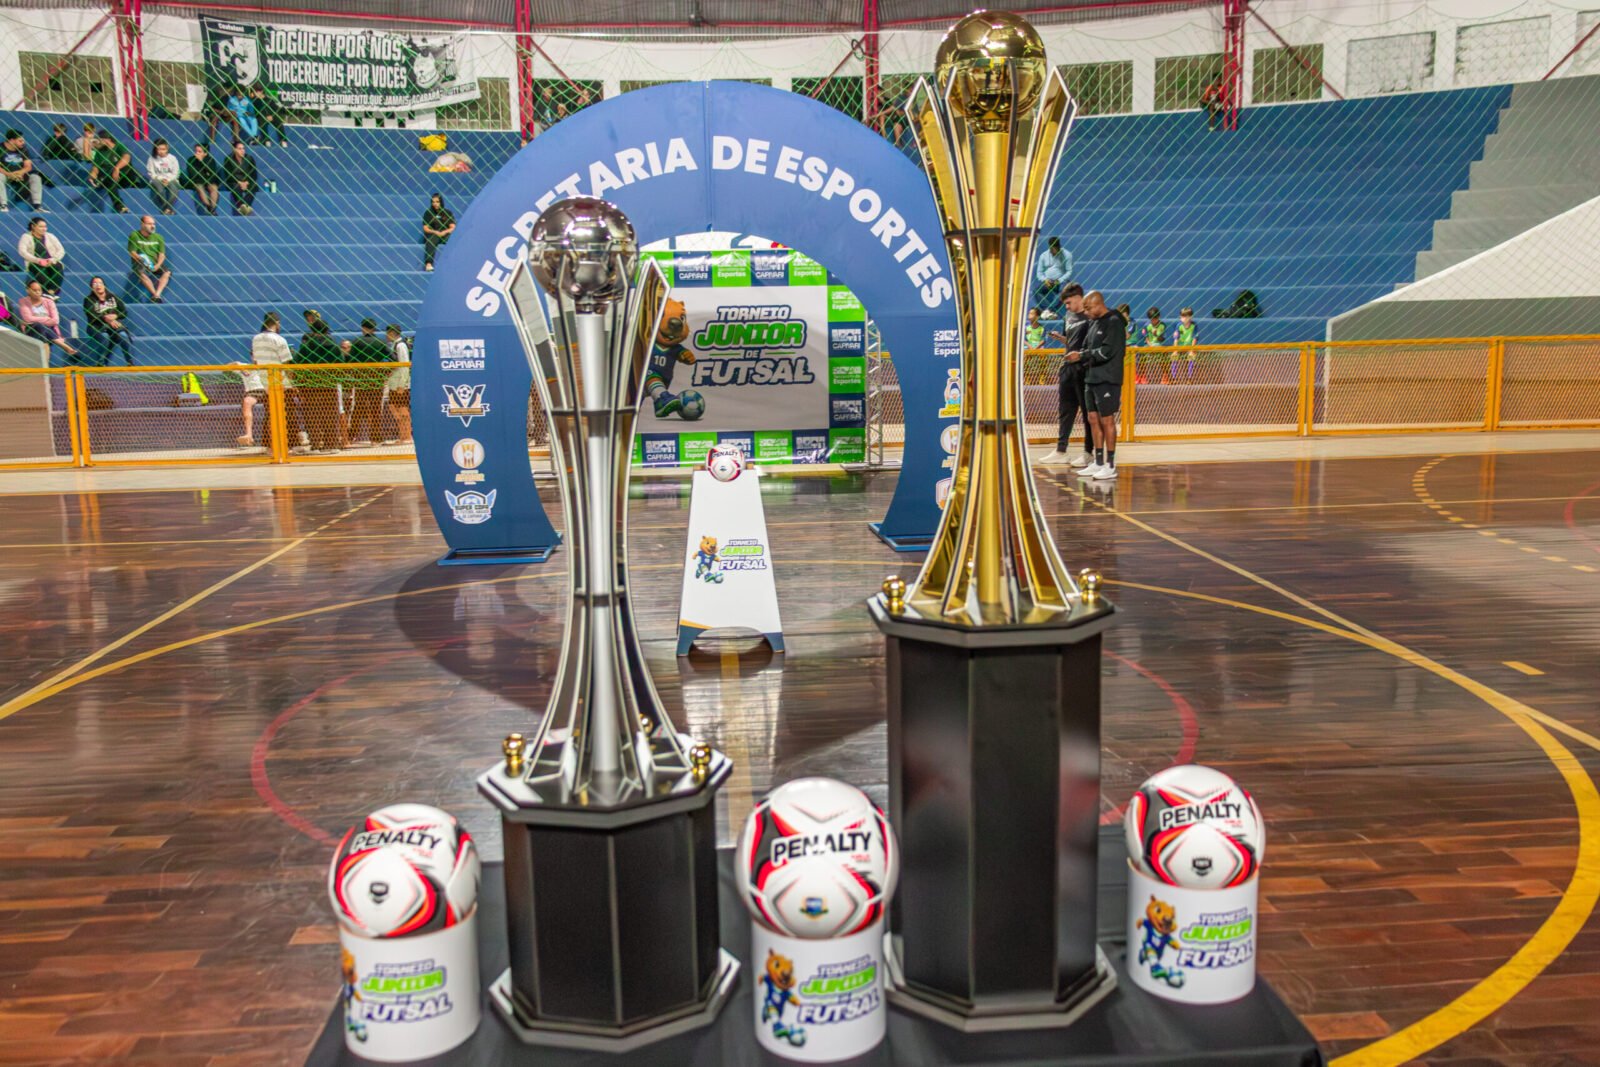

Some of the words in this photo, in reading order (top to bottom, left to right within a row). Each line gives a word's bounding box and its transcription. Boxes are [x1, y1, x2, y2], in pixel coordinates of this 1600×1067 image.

[266, 30, 332, 58] JOGUEM
[335, 34, 366, 59] POR
[267, 60, 344, 87] TORCEREMOS
[347, 64, 369, 88] POR
[371, 63, 407, 89] VOCÊS
[712, 135, 770, 174] DE
[773, 145, 953, 308] ESPORTES
[717, 306, 790, 321] TORNEIO
[695, 321, 805, 348] JUNIOR
[441, 360, 485, 369] CAPIVARI
[654, 355, 666, 366] 10
[744, 350, 761, 358] DE
[934, 348, 960, 357] Espor
[693, 358, 814, 385] FUTSAL
[712, 450, 738, 458] PENALTY
[720, 559, 766, 570] FUTSAL
[1162, 803, 1241, 827] PENALTY
[354, 830, 442, 851] PENALTY
[774, 831, 871, 862] PENALTY
[1178, 940, 1252, 967] FUTSAL
[362, 994, 451, 1021] FUTSAL
[798, 989, 879, 1023] FUTSAL
